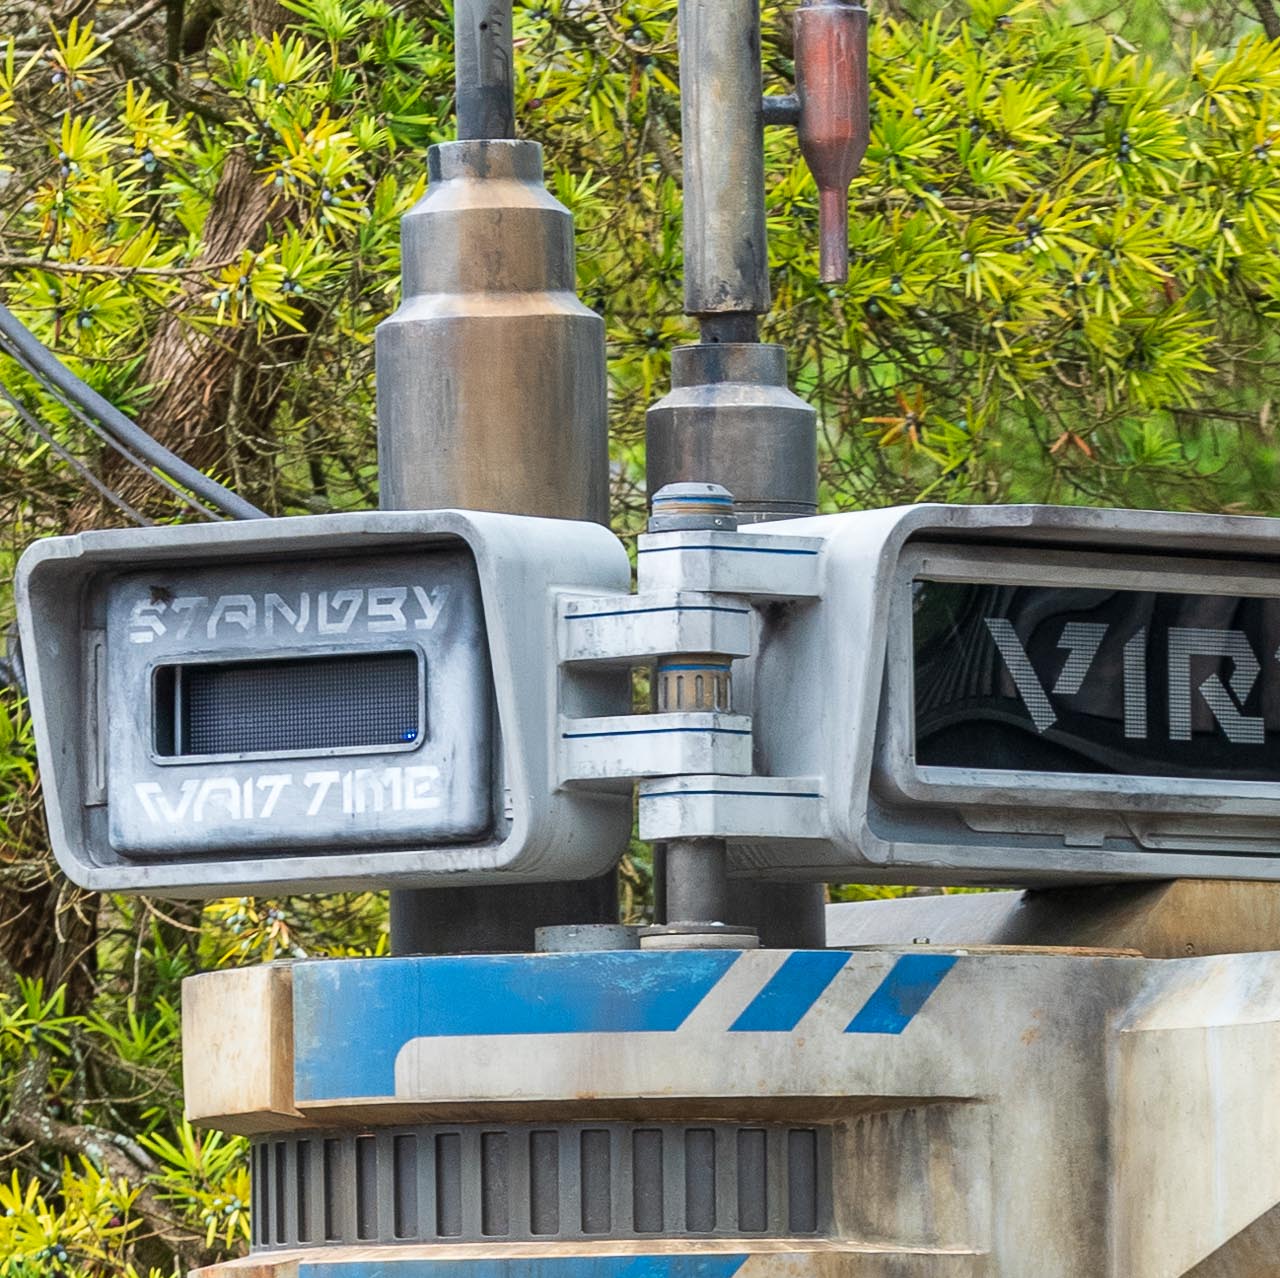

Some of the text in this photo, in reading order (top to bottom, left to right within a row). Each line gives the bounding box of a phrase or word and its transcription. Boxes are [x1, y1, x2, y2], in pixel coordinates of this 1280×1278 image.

[129, 585, 450, 644] STANDBY
[132, 765, 442, 824] WAIT TIME
